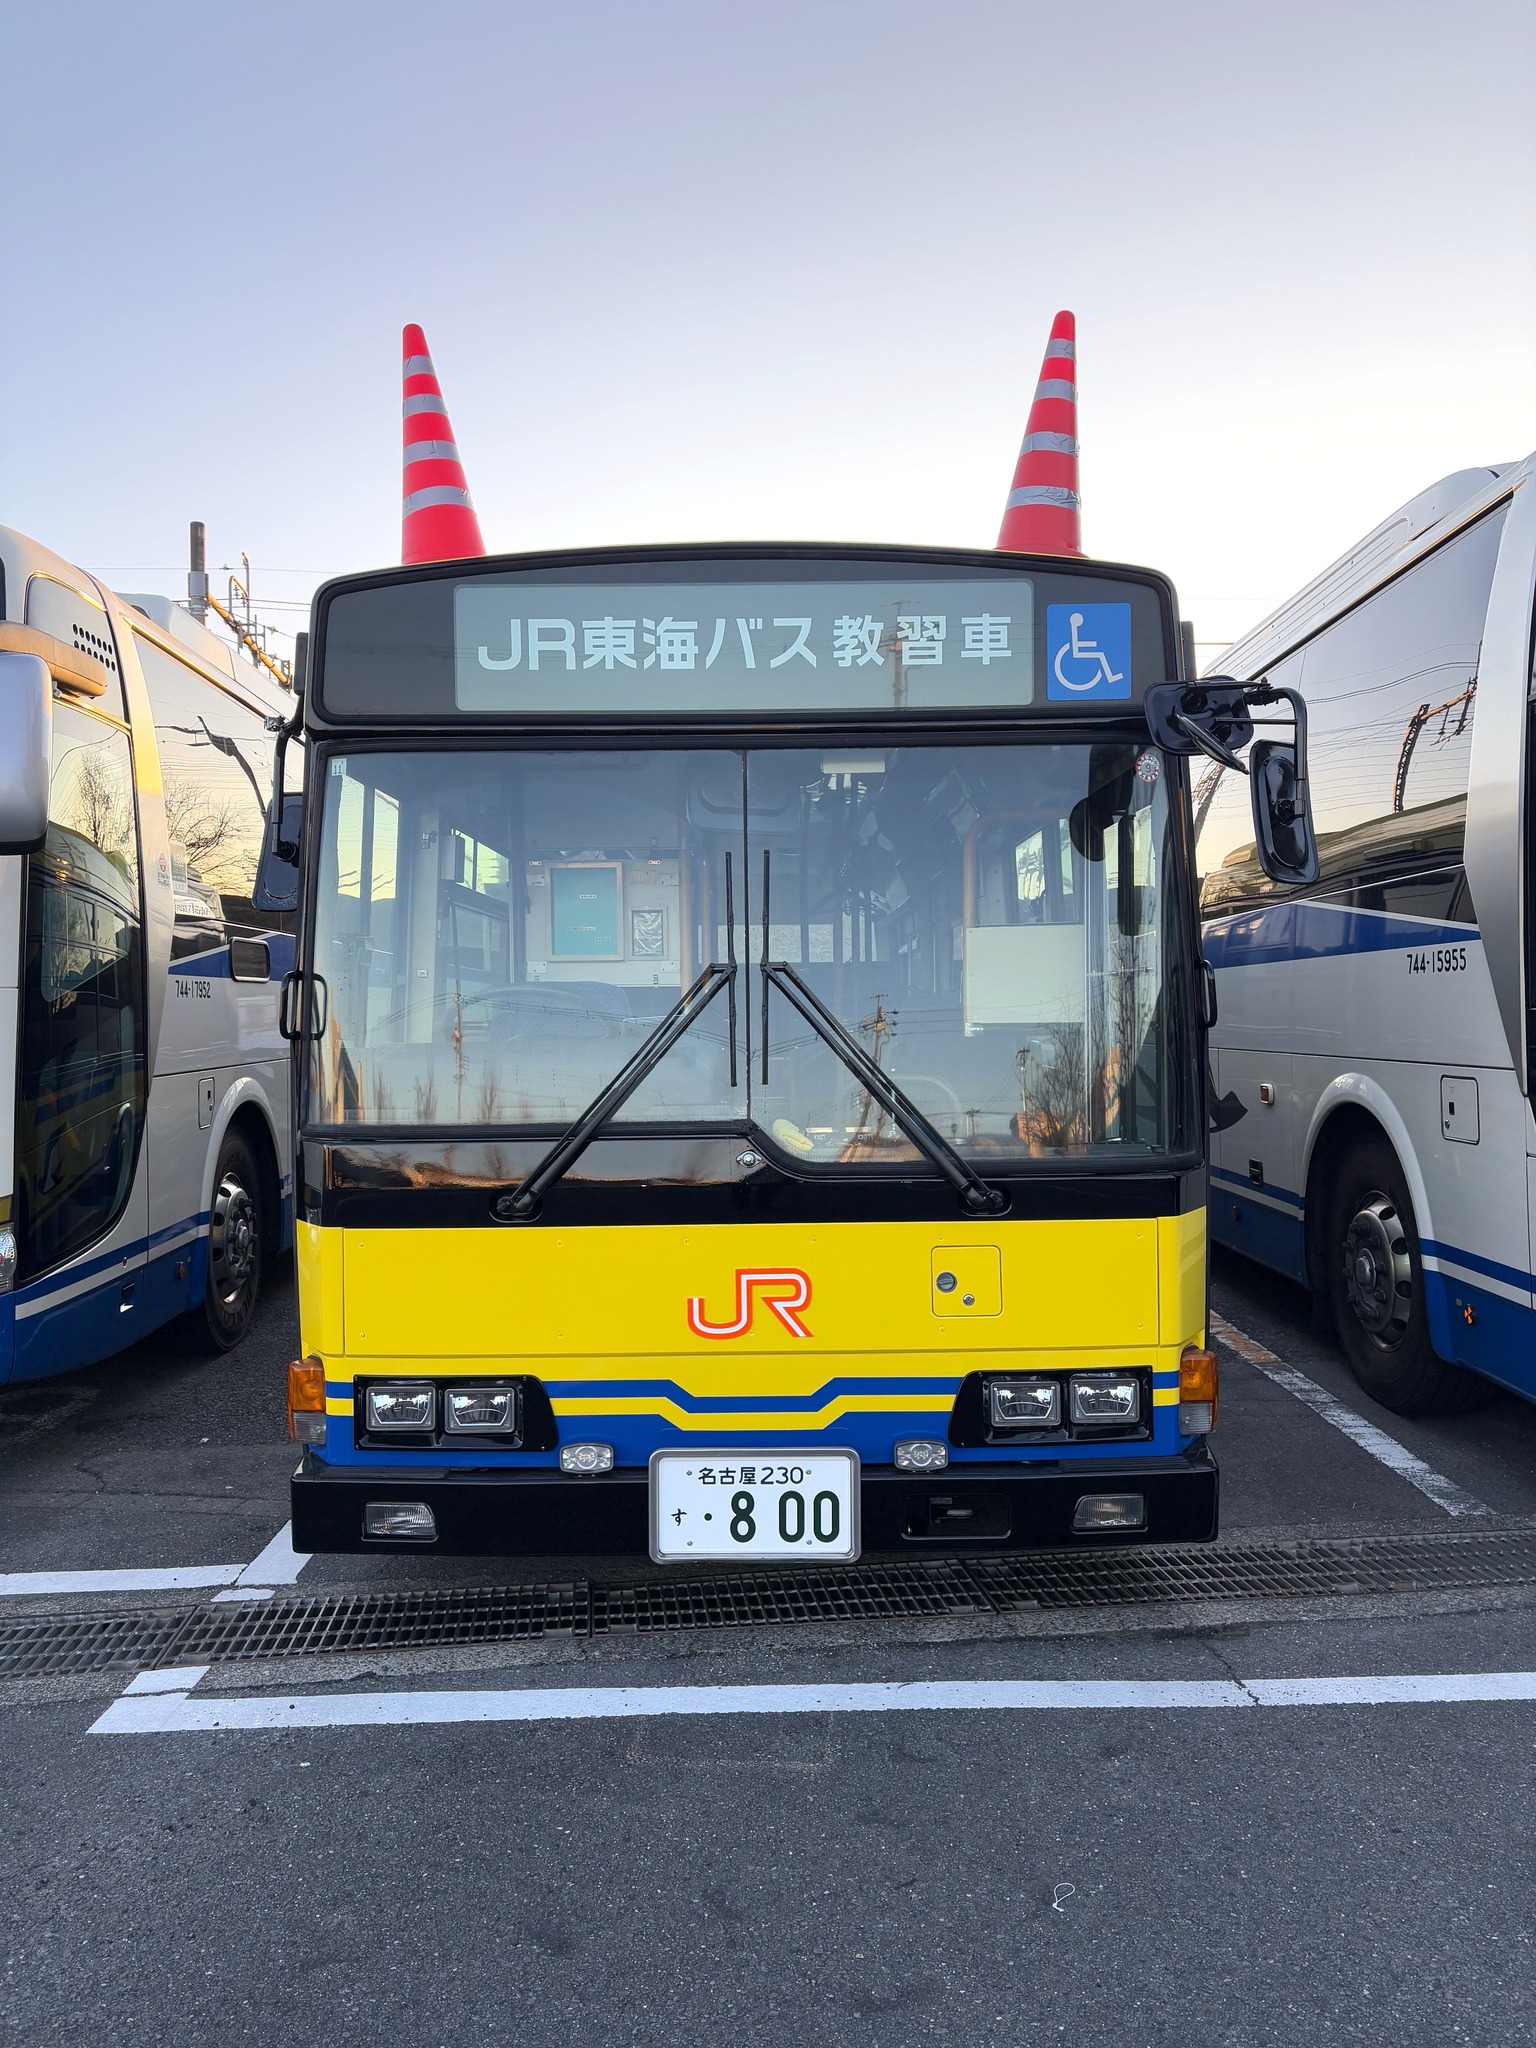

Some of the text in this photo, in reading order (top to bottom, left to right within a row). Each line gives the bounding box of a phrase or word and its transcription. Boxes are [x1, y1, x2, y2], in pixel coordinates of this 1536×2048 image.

[478, 613, 1012, 670] JR東海バス教習車
[687, 1268, 814, 1340] JR
[697, 1466, 805, 1486] 名古屋230
